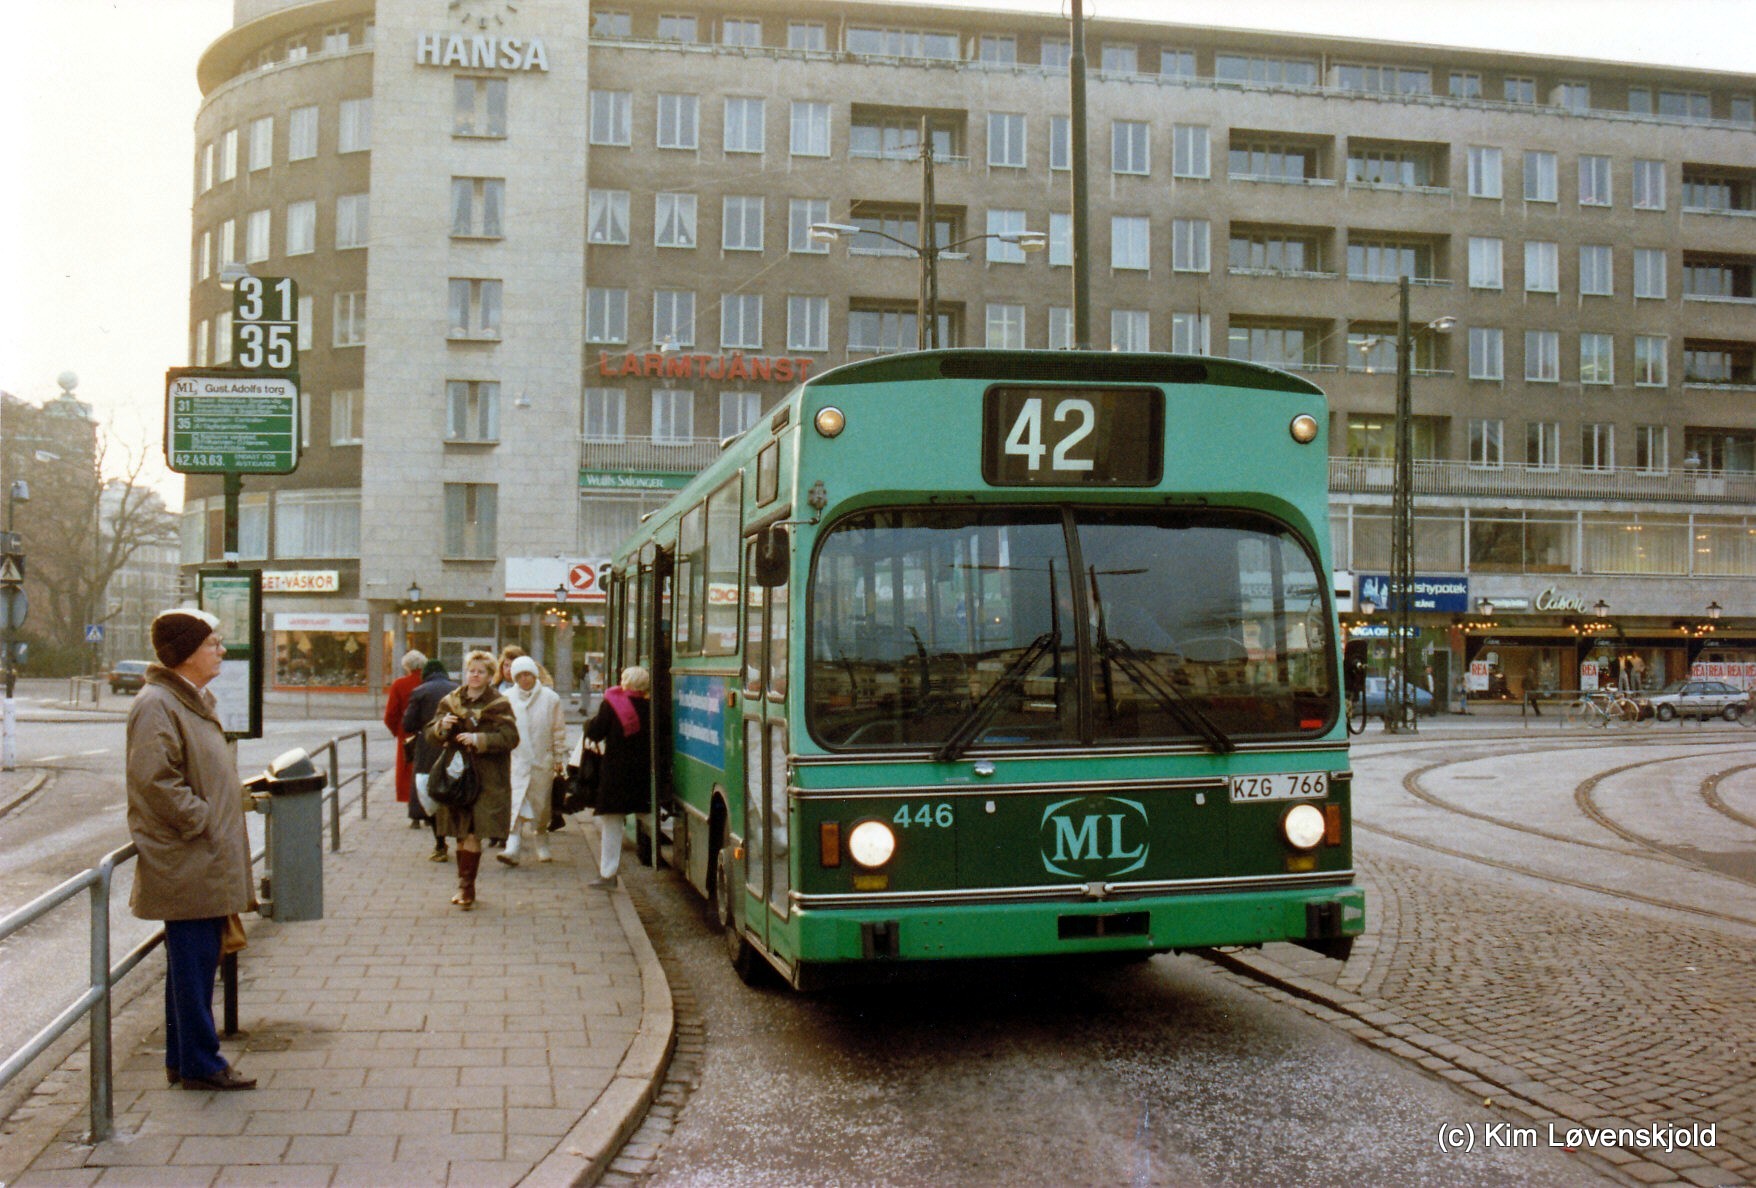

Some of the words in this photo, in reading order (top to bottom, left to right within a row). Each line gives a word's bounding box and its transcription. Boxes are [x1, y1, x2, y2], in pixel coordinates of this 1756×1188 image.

[416, 31, 549, 72] HANSA
[239, 276, 292, 321] 31
[239, 324, 293, 369] 35
[600, 352, 815, 383] LARMTJÄNST
[264, 384, 286, 396] torg
[178, 399, 190, 412] 31
[177, 417, 191, 430] 35
[1004, 398, 1095, 471] 42
[1391, 582, 1467, 596] sshypotek
[1471, 662, 1488, 677] REA
[1581, 664, 1598, 677] REA
[1692, 664, 1705, 677] REA
[1708, 664, 1723, 677] REA
[1727, 664, 1742, 677] REA
[1233, 779, 1273, 800] KZG
[1287, 775, 1326, 796] 766
[892, 802, 954, 829] 446
[1050, 813, 1146, 863] ML
